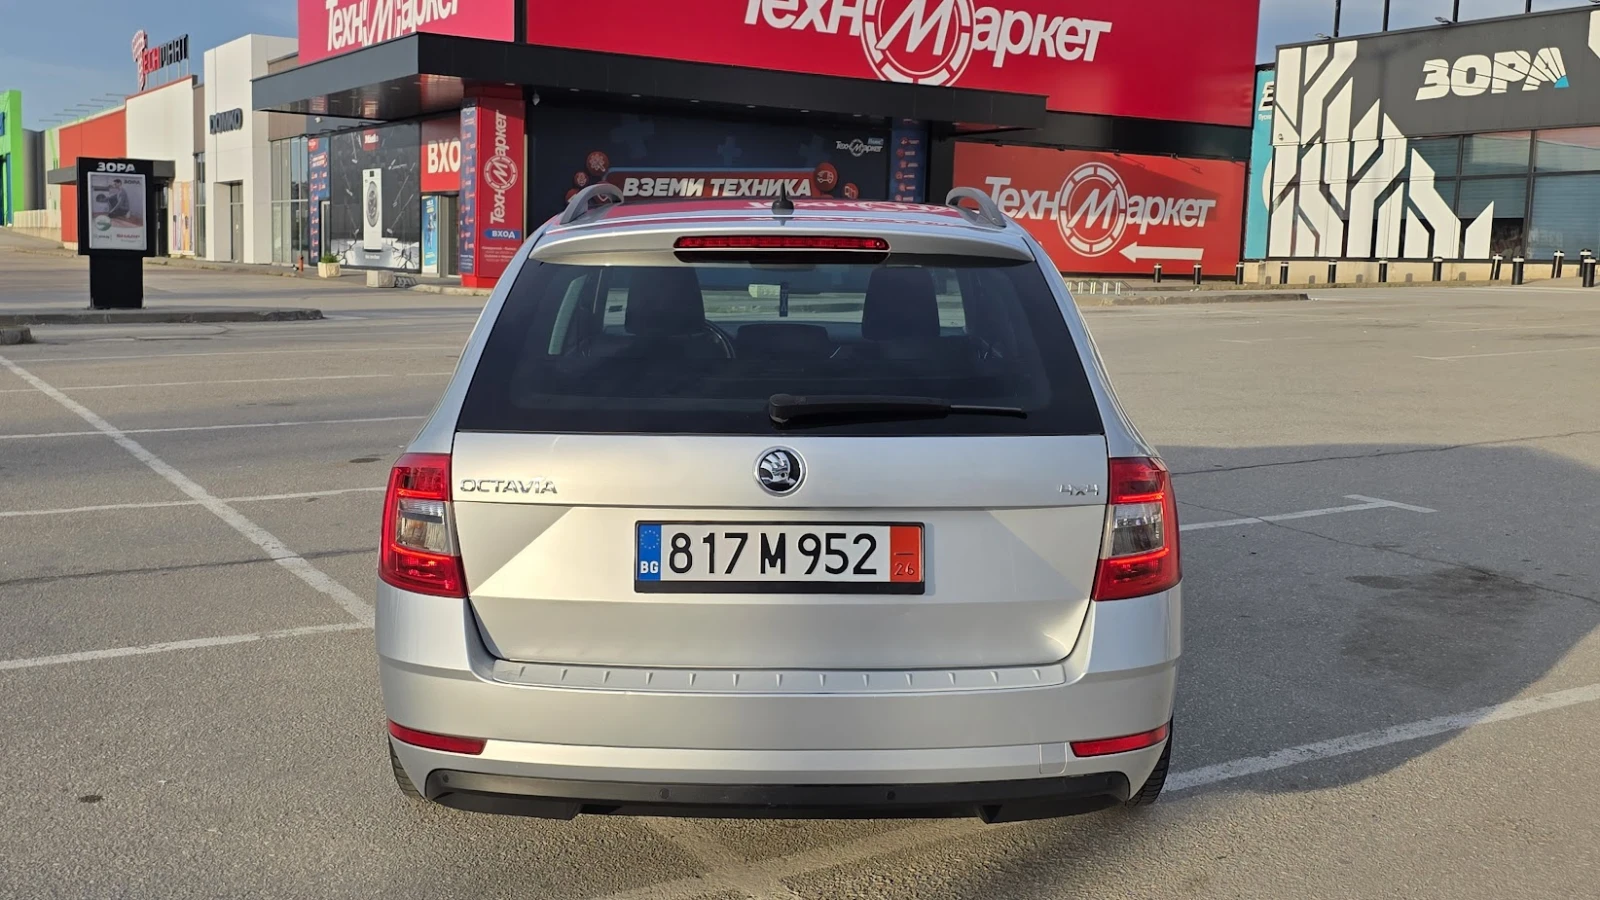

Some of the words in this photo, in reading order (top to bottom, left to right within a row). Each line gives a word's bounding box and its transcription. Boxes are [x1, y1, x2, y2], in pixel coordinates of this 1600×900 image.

[1415, 46, 1570, 101] ЗОРА
[427, 137, 461, 174] ВХО
[96, 161, 136, 173] ЗОРА
[622, 177, 705, 197] ВЗЕМИ
[710, 178, 812, 197] ТЕХНИКА
[491, 230, 516, 239] ВХОД
[460, 479, 558, 494] OCTAVIA
[640, 560, 659, 574] BG
[669, 532, 749, 574] 817
[797, 532, 878, 575] 952
[894, 562, 915, 576] 26
